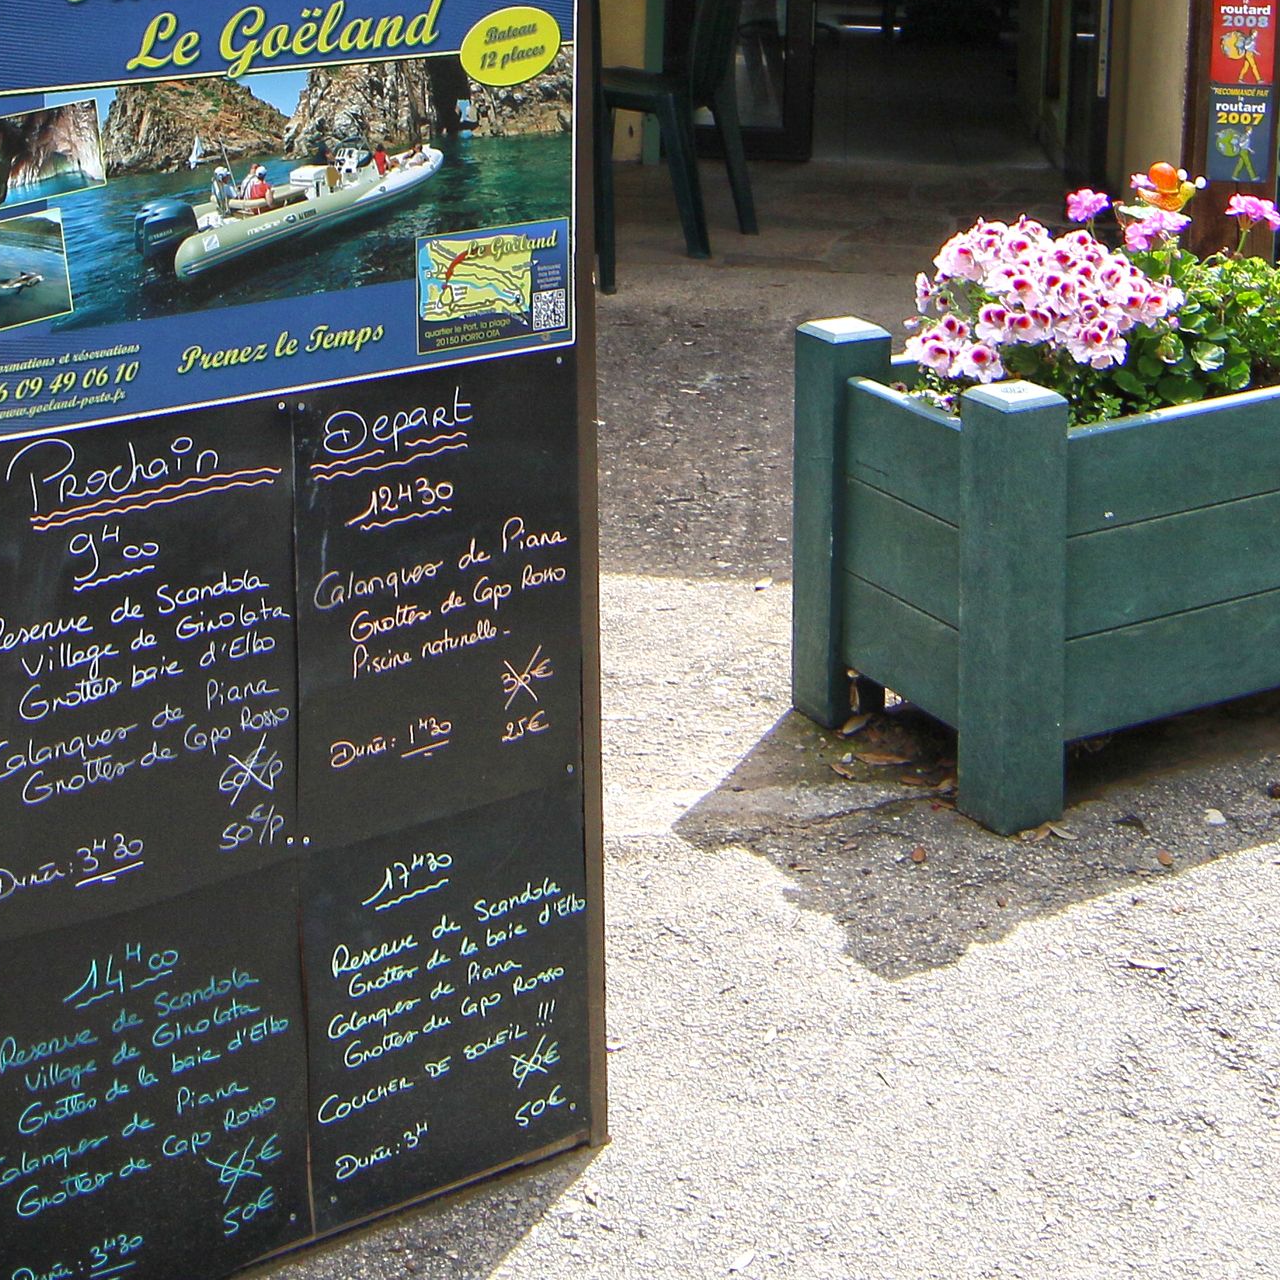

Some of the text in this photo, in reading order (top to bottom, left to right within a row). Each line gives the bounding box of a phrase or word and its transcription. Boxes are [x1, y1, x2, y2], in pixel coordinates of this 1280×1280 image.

[1220, 4, 1271, 15] routard
[1222, 16, 1269, 27] 2008
[127, 11, 201, 72] Le
[483, 20, 538, 45] Bateau
[479, 43, 546, 71] 12 places
[1216, 101, 1266, 112] routard
[1217, 112, 1264, 124] 2007
[465, 229, 557, 260] Le Goëland
[424, 328, 453, 338] quartier
[489, 319, 511, 330] plage
[436, 330, 500, 347] 20150 PORTO OTA
[59, 353, 69, 364] et
[72, 343, 140, 363] réservations
[176, 322, 385, 375] Prenez le Temps
[15, 376, 43, 399] 09
[49, 372, 77, 394] 49
[82, 366, 109, 388] 06
[114, 361, 140, 384] 10
[322, 385, 474, 454] Depart
[6, 437, 219, 512] Prochain
[458, 538, 491, 571] de
[500, 516, 568, 553] Piana
[111, 598, 146, 623] de
[156, 571, 270, 615] Scandola
[21, 642, 120, 680] Village
[130, 633, 158, 654] de
[352, 624, 498, 680] Piscine naturelle
[131, 654, 184, 689] baie
[317, 1023, 528, 1125] COUCHER DE SOLEIL
